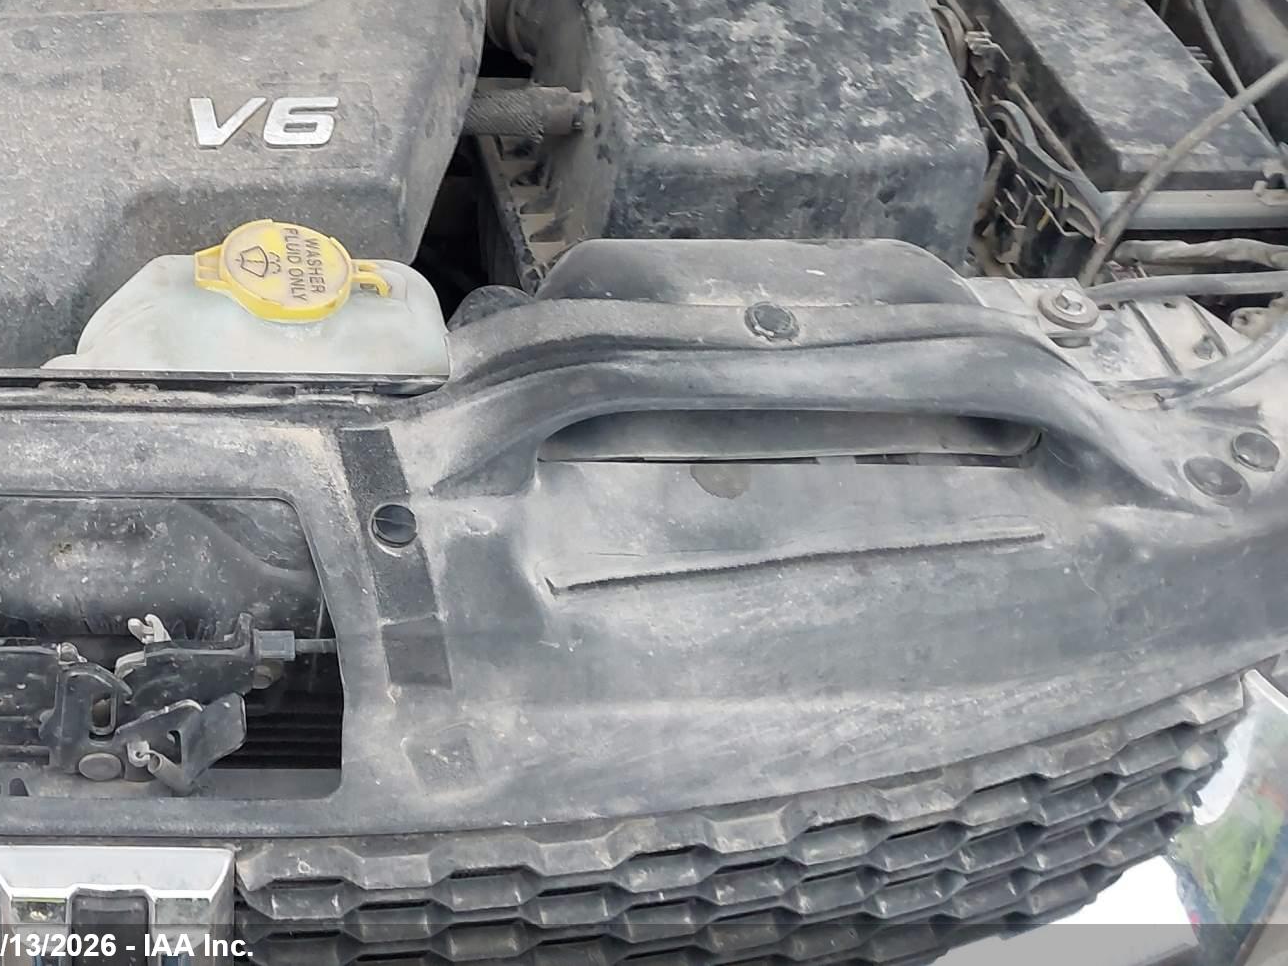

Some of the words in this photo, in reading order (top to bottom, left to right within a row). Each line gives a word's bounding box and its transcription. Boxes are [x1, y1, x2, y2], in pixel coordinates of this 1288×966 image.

[189, 97, 340, 149] V6
[283, 227, 302, 265] FLUID
[304, 237, 326, 294] WASHER
[289, 266, 307, 302] ONLY
